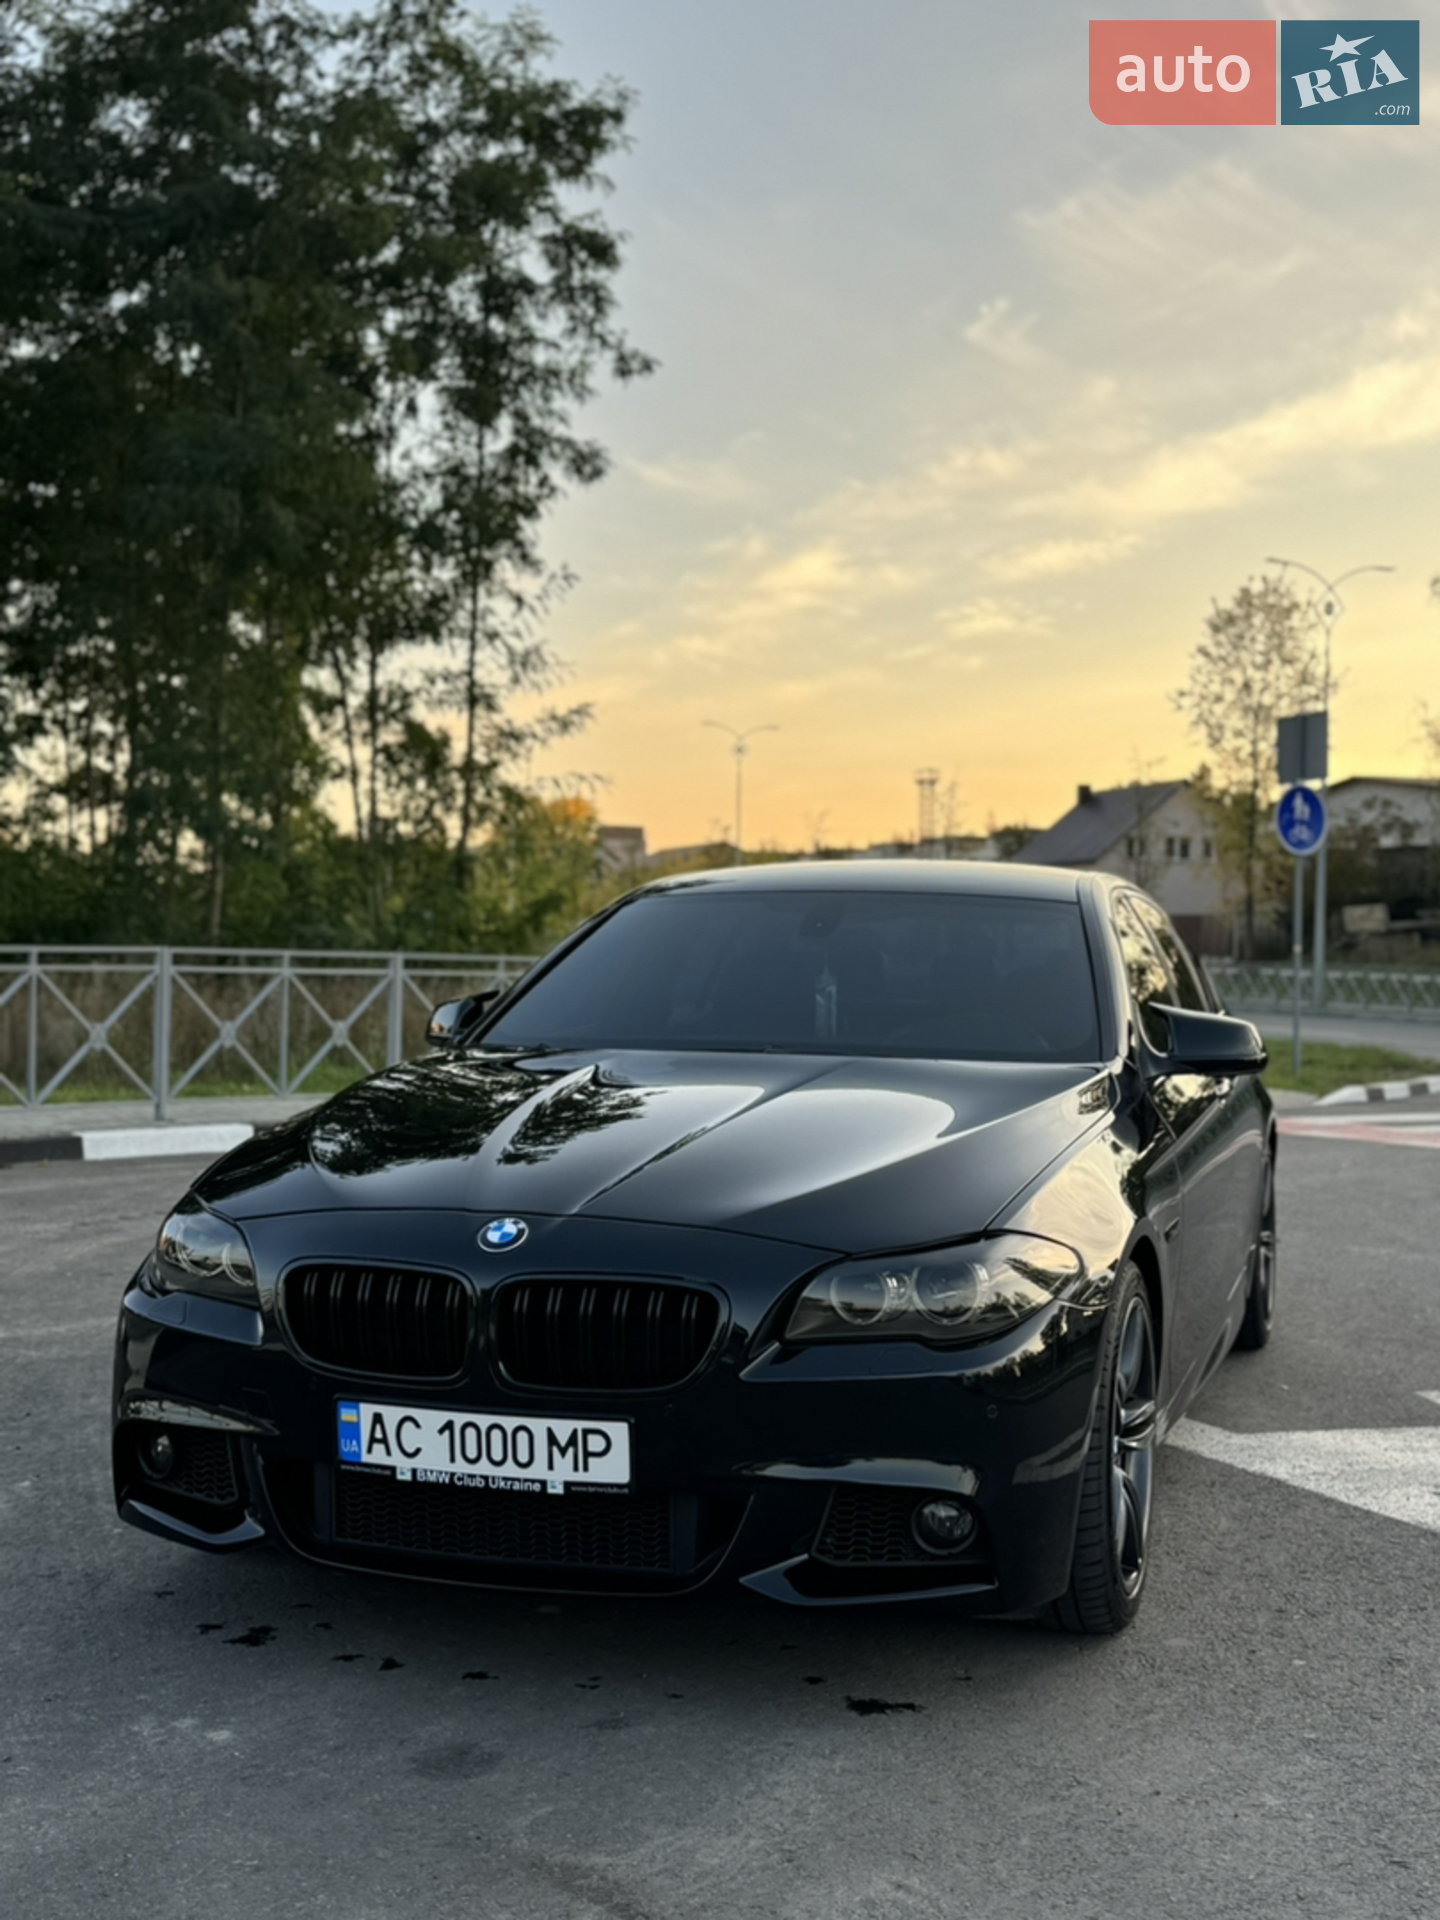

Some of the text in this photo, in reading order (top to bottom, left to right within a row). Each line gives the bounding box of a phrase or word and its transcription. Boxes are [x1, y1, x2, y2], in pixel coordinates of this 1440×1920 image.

[340, 1438, 361, 1453] UA
[366, 1411, 613, 1473] AC 1000 MP
[416, 1468, 542, 1492] BMW Club Ukraine
